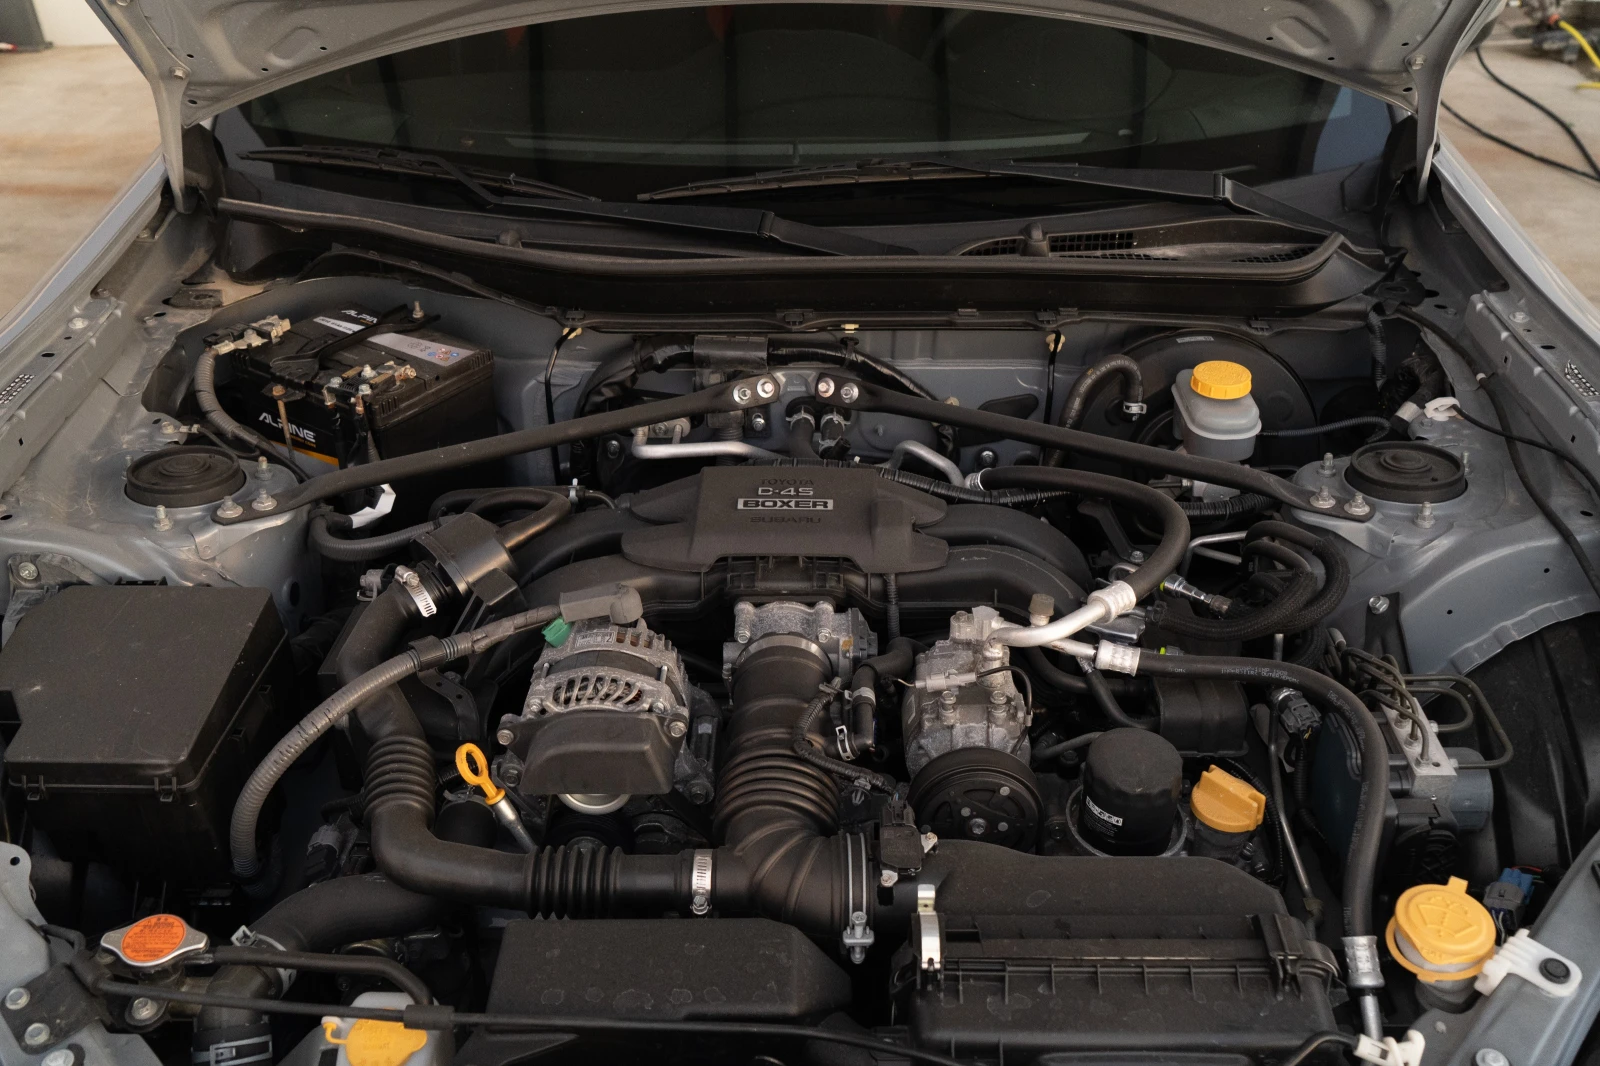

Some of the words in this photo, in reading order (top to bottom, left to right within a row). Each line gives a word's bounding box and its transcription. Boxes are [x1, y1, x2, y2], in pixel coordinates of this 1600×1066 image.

[341, 309, 378, 324] ALPIN
[742, 500, 829, 509] BOXER
[750, 516, 821, 524] SUBARU
